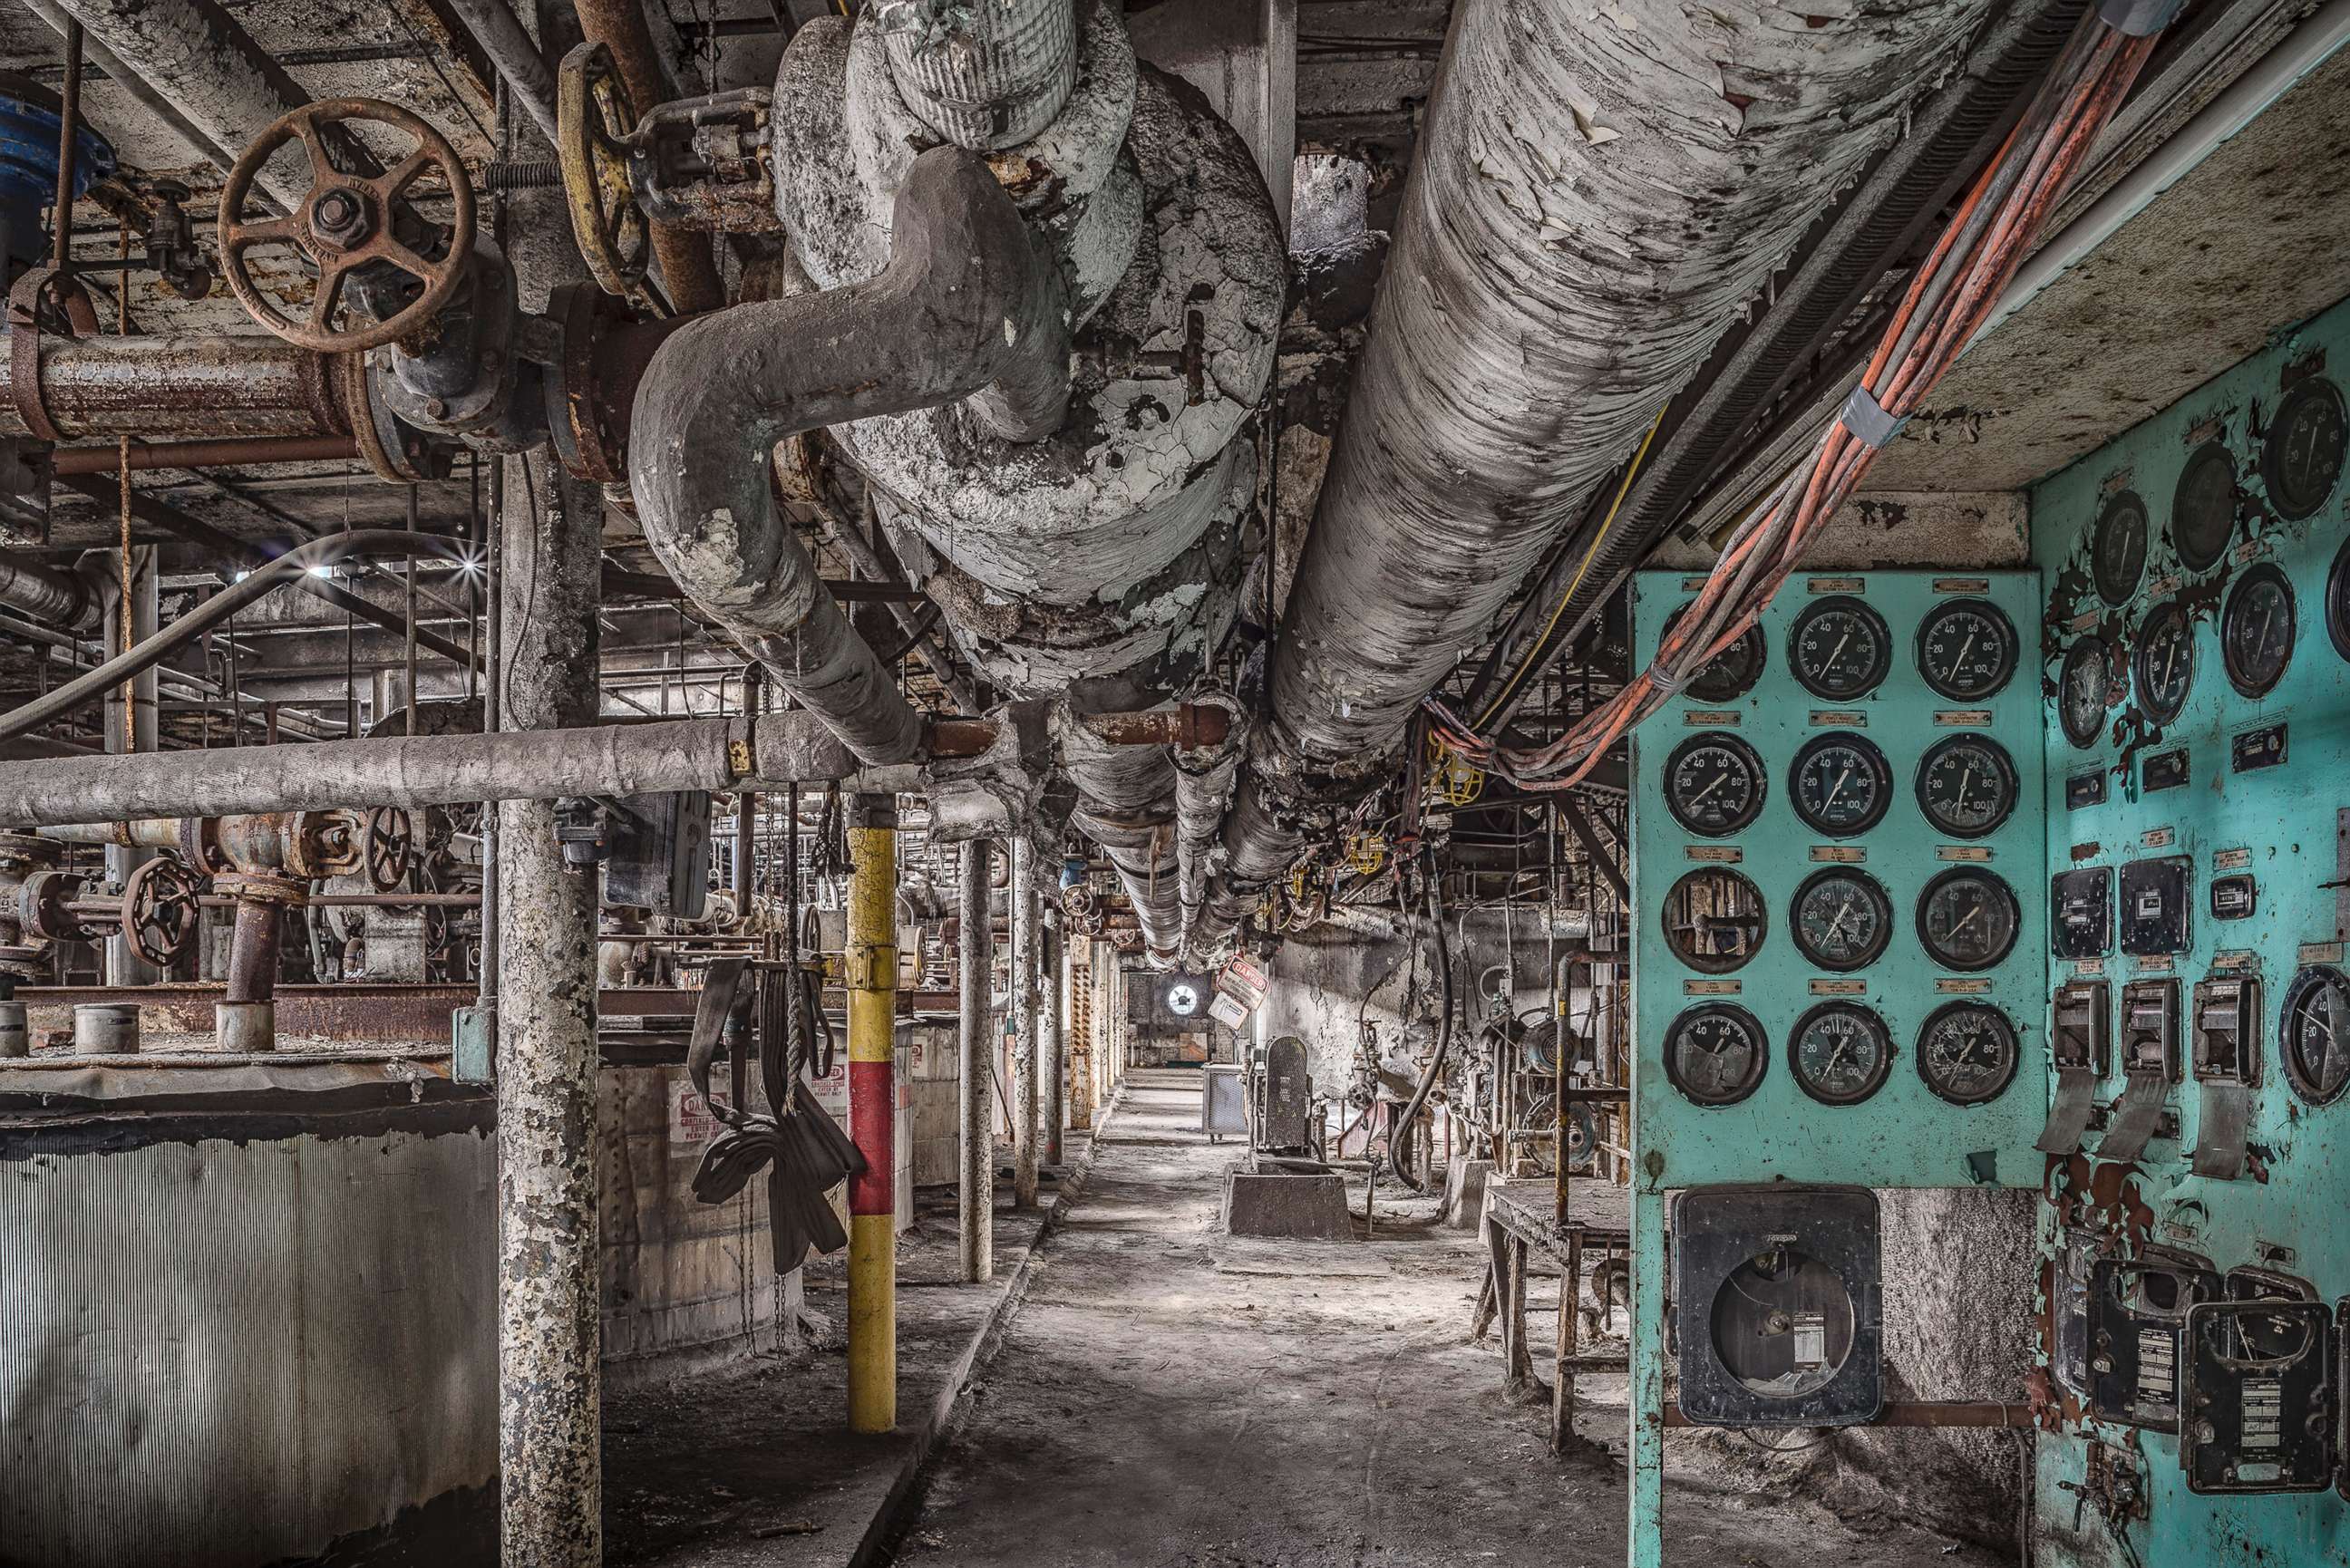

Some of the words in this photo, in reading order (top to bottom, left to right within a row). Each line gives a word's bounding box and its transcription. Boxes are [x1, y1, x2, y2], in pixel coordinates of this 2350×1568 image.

[1843, 624, 1854, 632] 60
[1945, 625, 1955, 634] 40
[1730, 643, 1740, 651] 80
[1807, 641, 1817, 650] 20
[1933, 645, 1943, 653] 20
[1983, 642, 1993, 650] 80
[1846, 666, 1859, 674] 100
[1974, 664, 1987, 673] 100
[2153, 661, 2160, 671] 20
[1968, 761, 1979, 769] 60
[1682, 778, 1692, 786] 20
[1731, 778, 1742, 786] 80
[1807, 778, 1817, 786] 20
[1857, 778, 1867, 787] 80
[1933, 780, 1942, 788] 20
[1982, 779, 1993, 787] 80
[1815, 800, 1821, 808] 0
[1847, 800, 1860, 808] 100
[1941, 802, 1947, 810] 0
[1973, 801, 1985, 809] 100
[1972, 894, 1983, 902] 60
[1807, 911, 1817, 919] 20
[1935, 911, 1945, 919] 20
[1234, 964, 1263, 988] DANGER
[2318, 1001, 2327, 1011] 40
[1720, 1027, 1730, 1035] 60
[2308, 1026, 2316, 1037] 20
[1983, 1045, 1994, 1053] 80
[2314, 1056, 2318, 1065] 0
